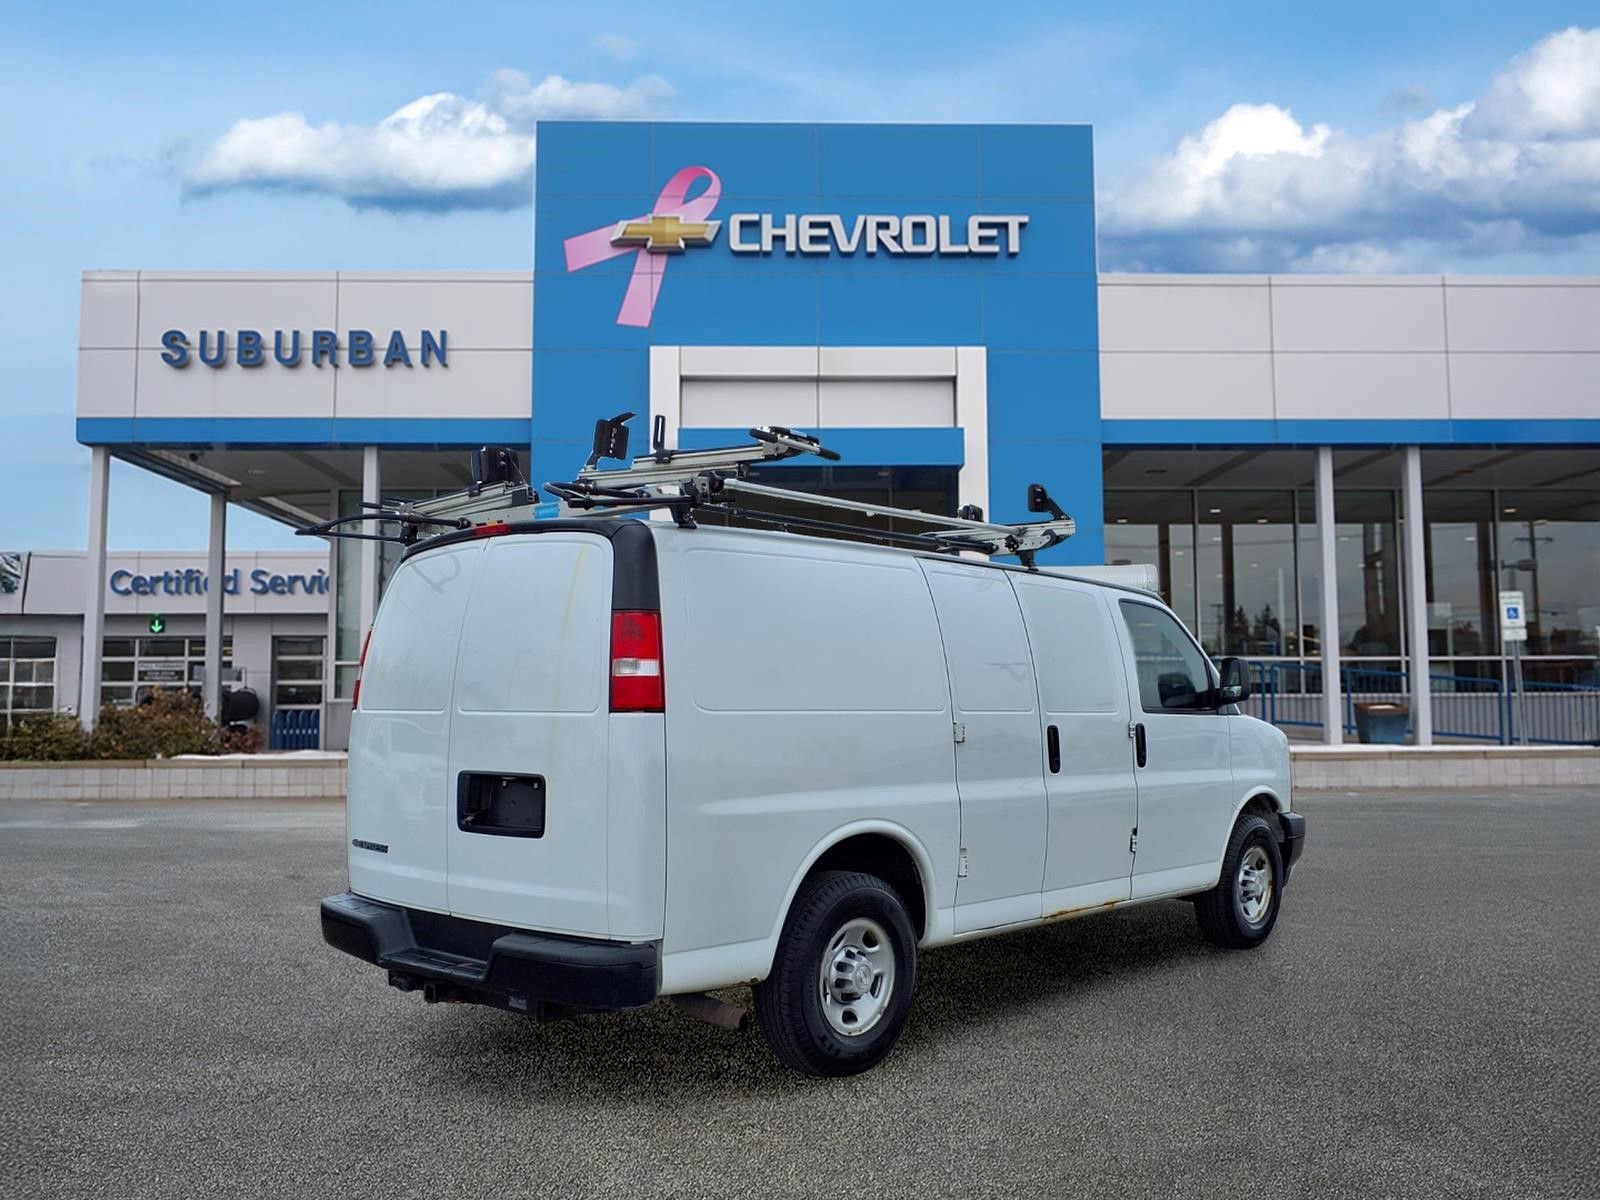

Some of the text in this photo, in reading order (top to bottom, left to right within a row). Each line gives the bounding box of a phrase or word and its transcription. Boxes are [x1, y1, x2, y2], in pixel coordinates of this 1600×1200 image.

[728, 213, 1029, 254] CHEVROLET
[161, 329, 449, 369] SUBURBAN
[109, 568, 329, 596] Certifid Servi
